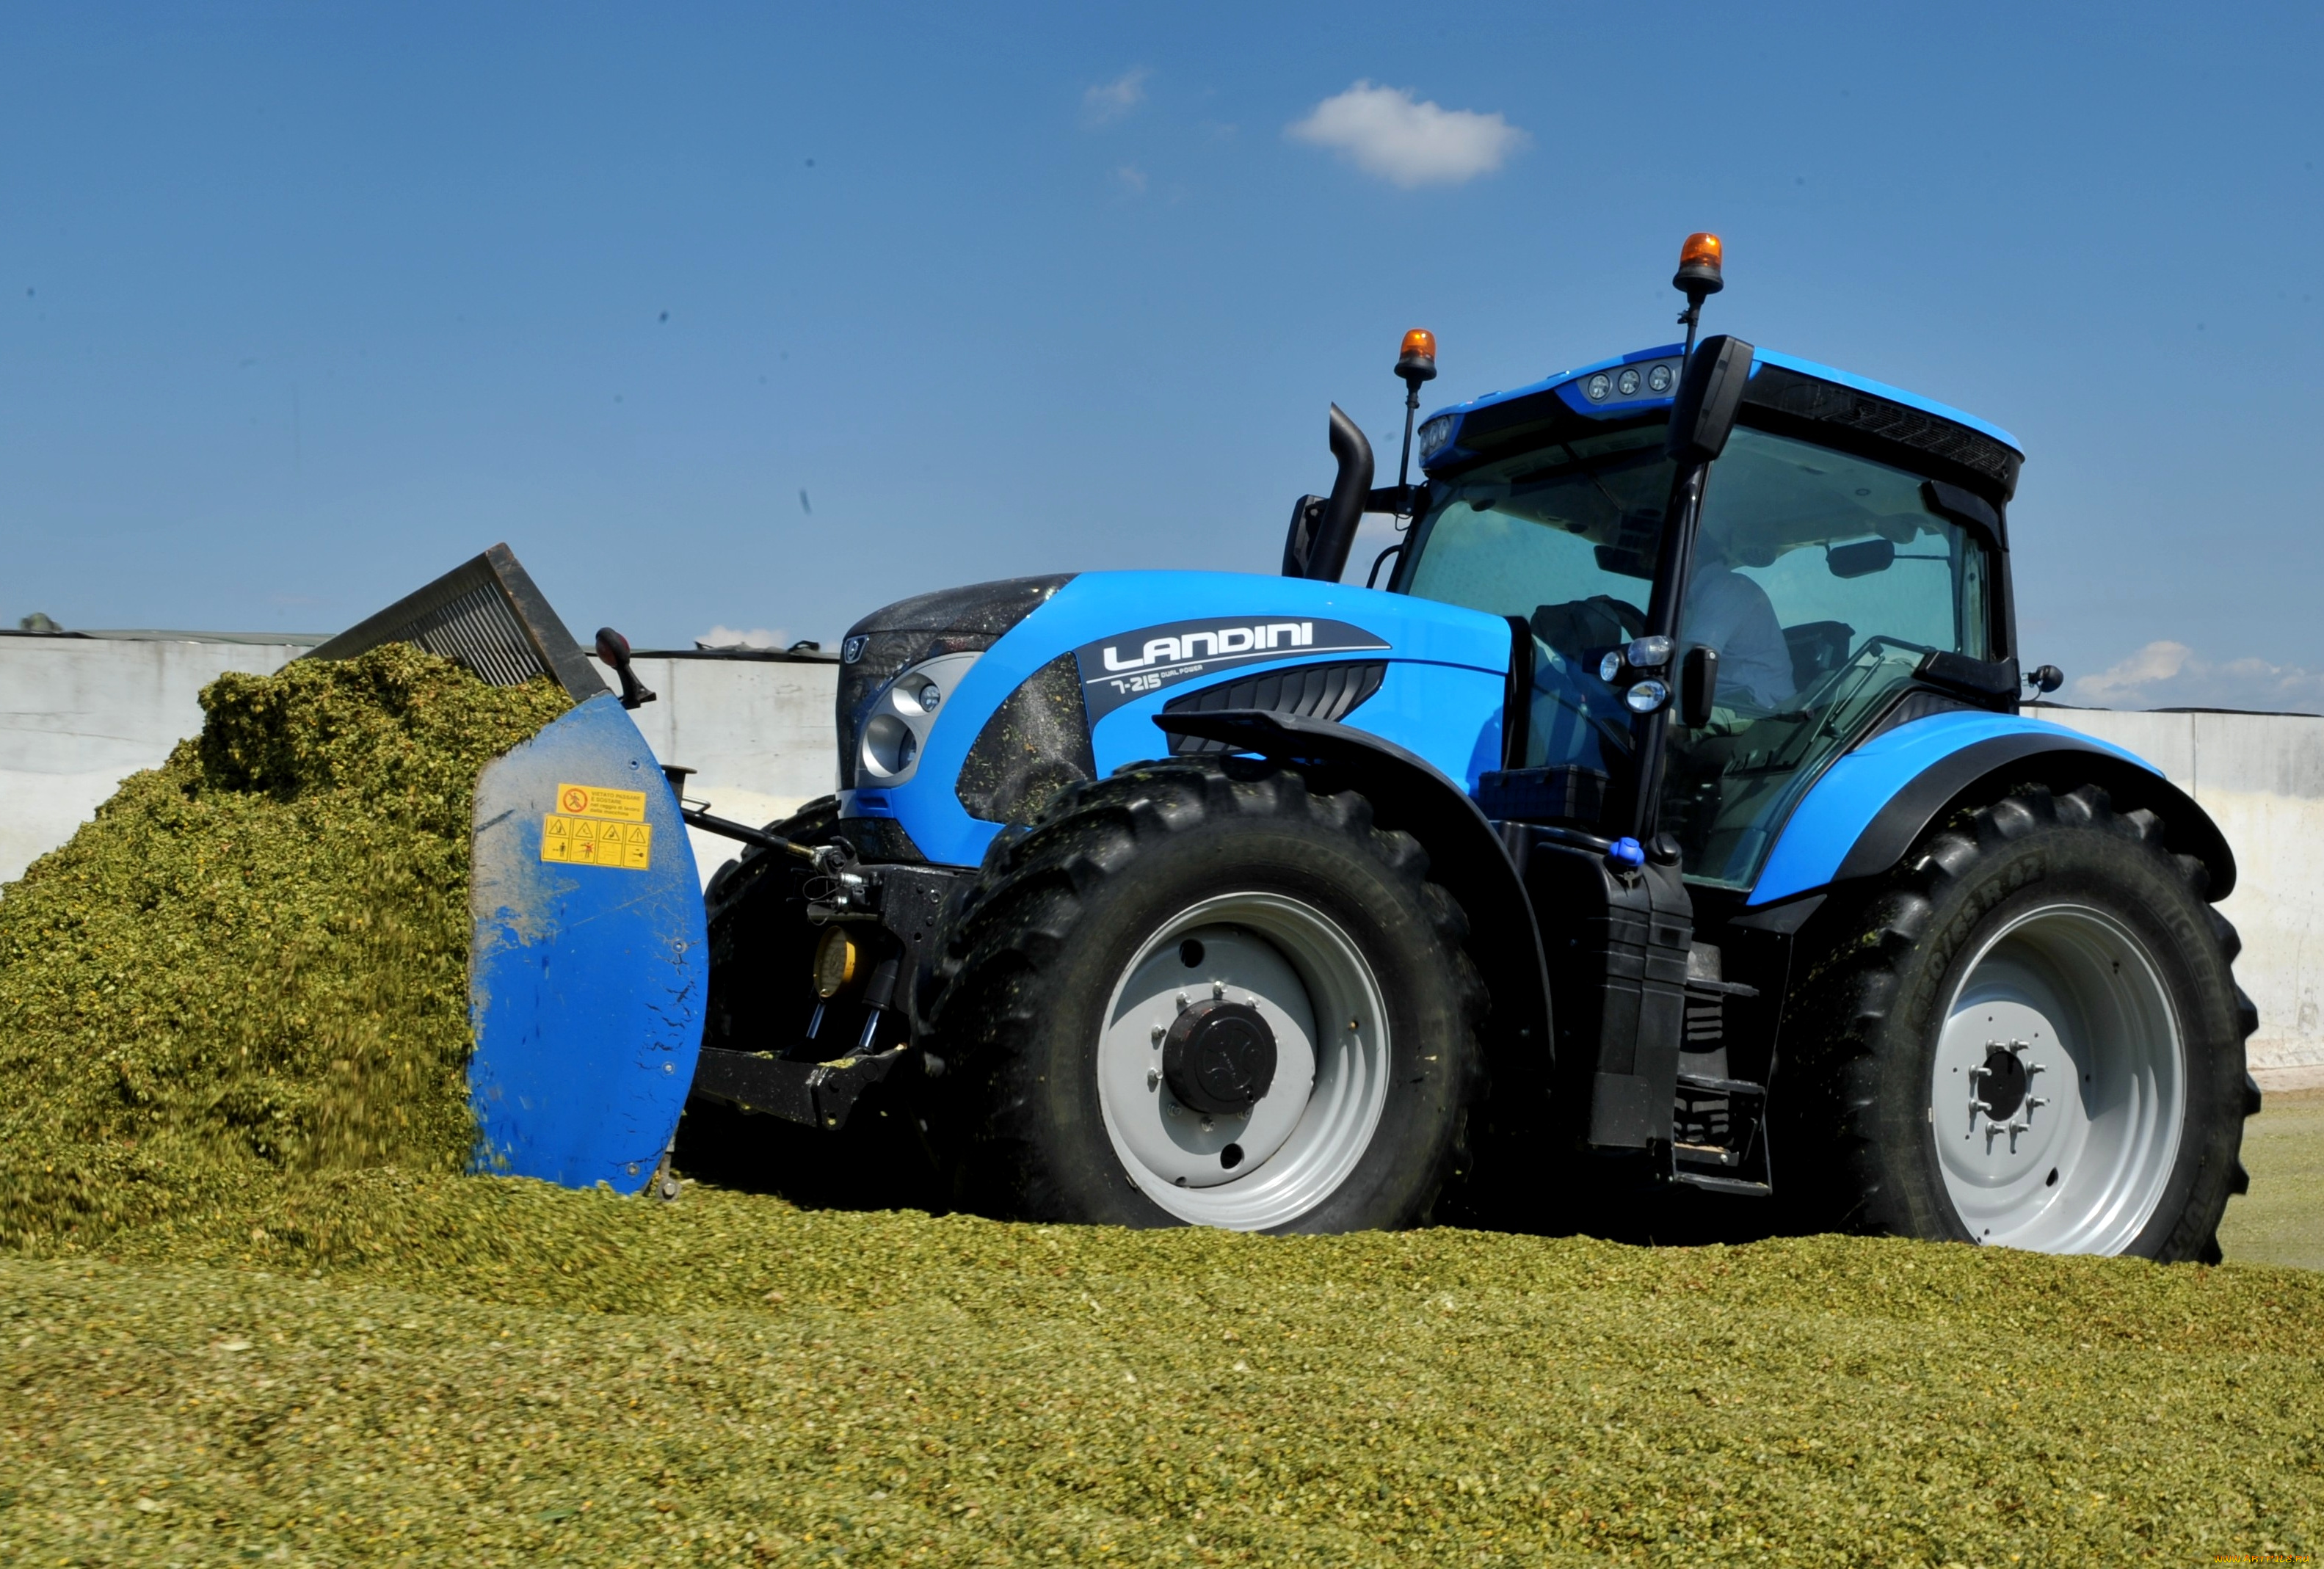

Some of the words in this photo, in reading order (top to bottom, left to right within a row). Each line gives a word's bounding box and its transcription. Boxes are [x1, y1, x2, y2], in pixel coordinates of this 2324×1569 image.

[1103, 622, 1313, 671] LANDINI
[1111, 673, 1161, 694] 7-215
[1161, 669, 1179, 678] DUAL
[1179, 664, 1203, 674] POWER
